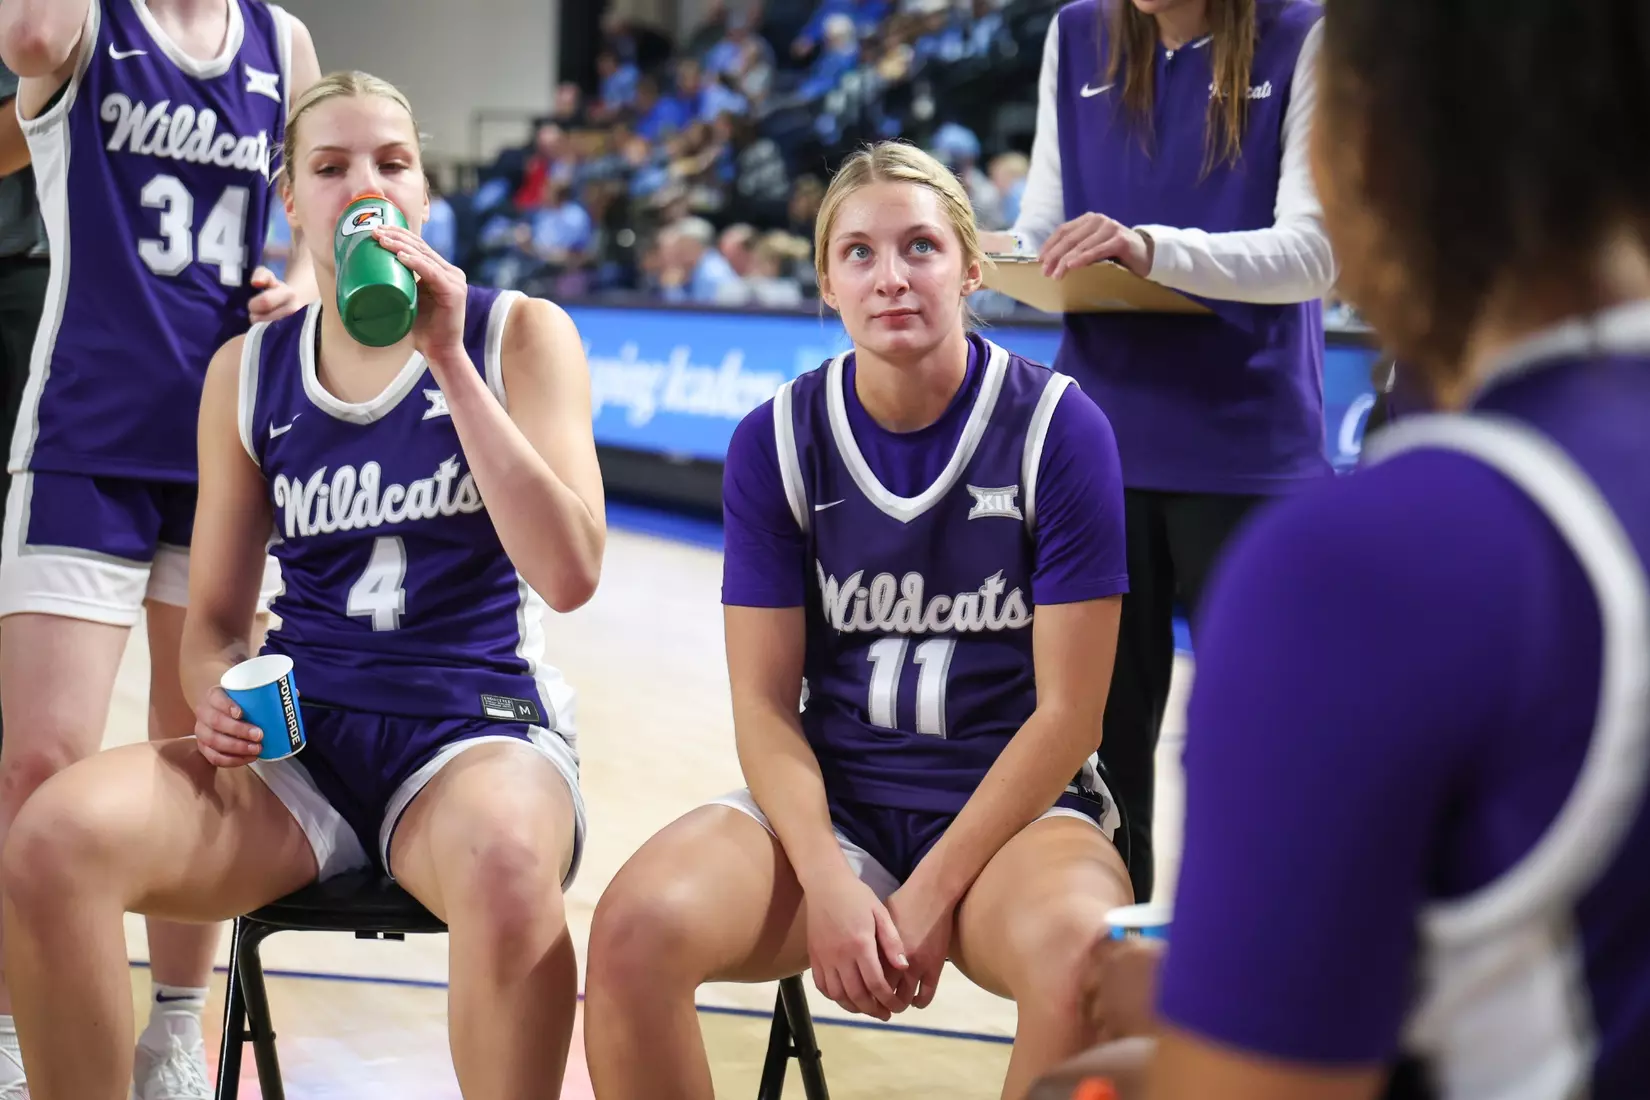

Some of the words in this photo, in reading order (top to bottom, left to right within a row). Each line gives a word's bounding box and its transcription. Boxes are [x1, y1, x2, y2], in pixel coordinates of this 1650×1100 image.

[1208, 80, 1272, 99] cats
[101, 93, 270, 182] Wildcat
[138, 175, 249, 286] 34
[274, 453, 486, 538] Wildcats
[972, 489, 1015, 514] XII
[347, 535, 407, 632] 4
[815, 558, 1033, 635] Wildcats
[279, 675, 301, 745] POWERADE
[519, 705, 531, 715] M
[867, 637, 957, 739] 11
